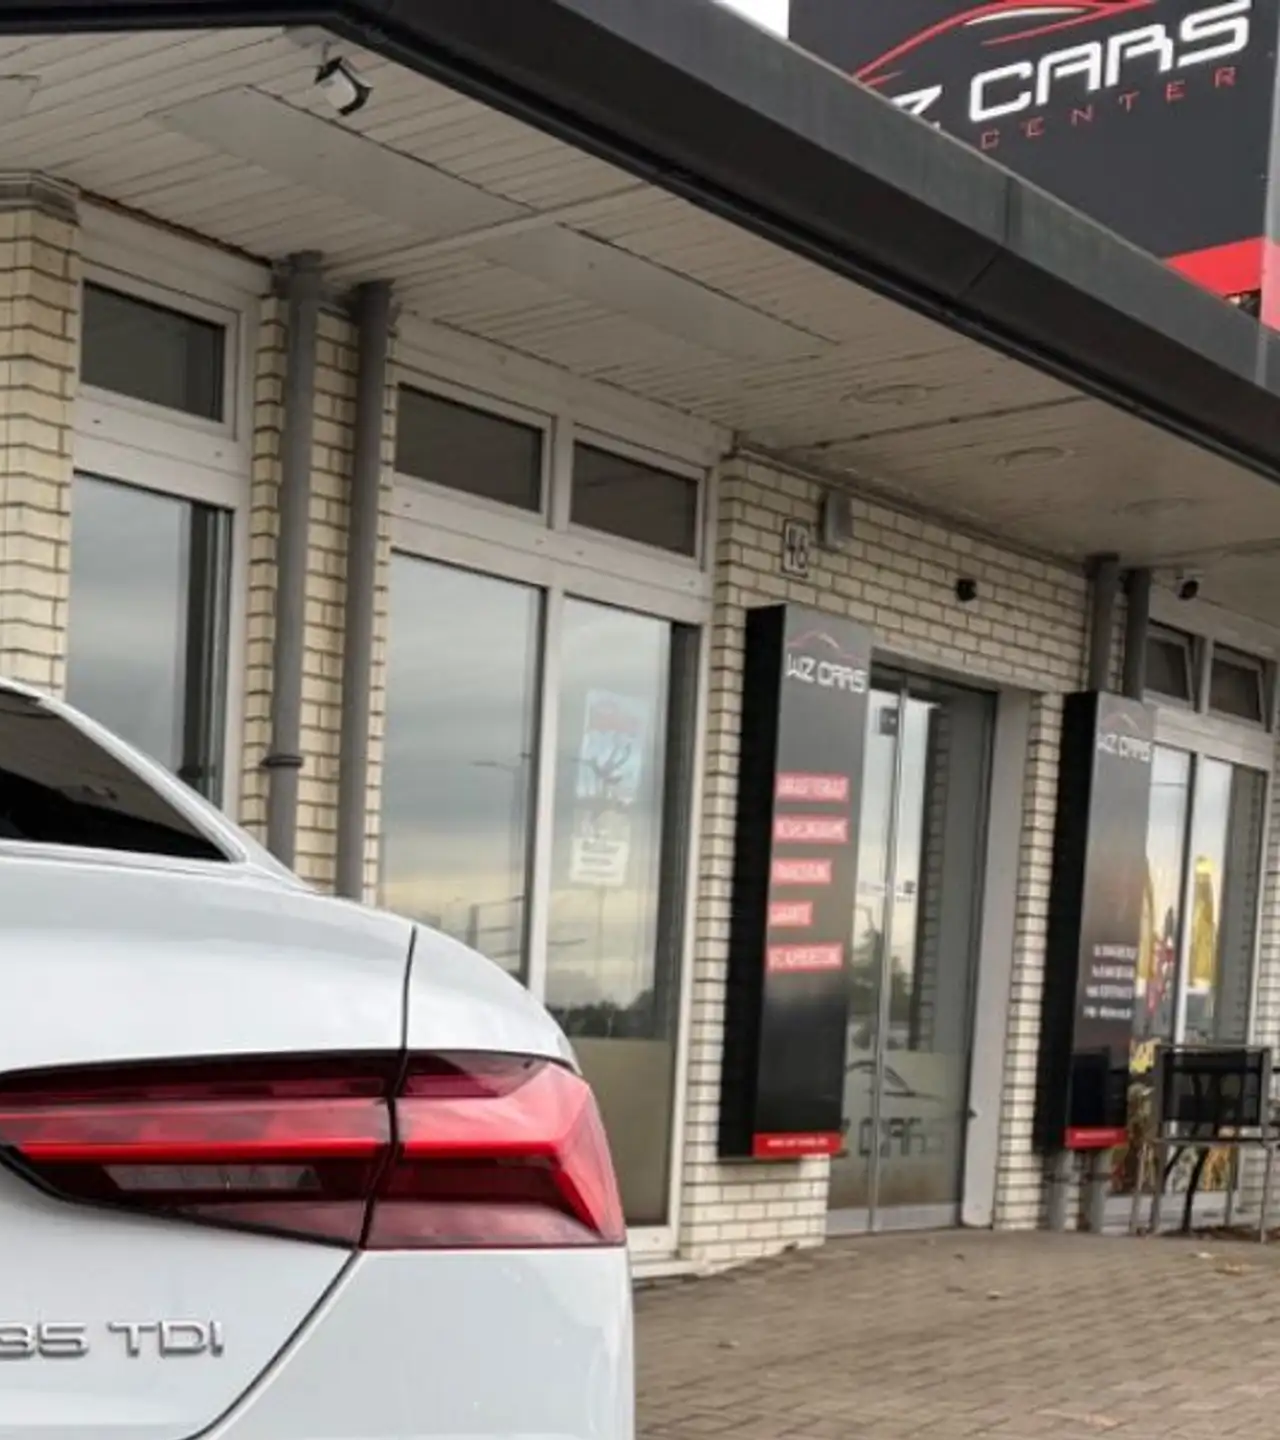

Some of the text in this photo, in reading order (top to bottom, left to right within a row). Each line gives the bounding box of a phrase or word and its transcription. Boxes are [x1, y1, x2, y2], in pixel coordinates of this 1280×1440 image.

[968, 0, 1252, 123] CARS
[979, 66, 1236, 150] CENTER
[106, 1319, 225, 1360] TDI
